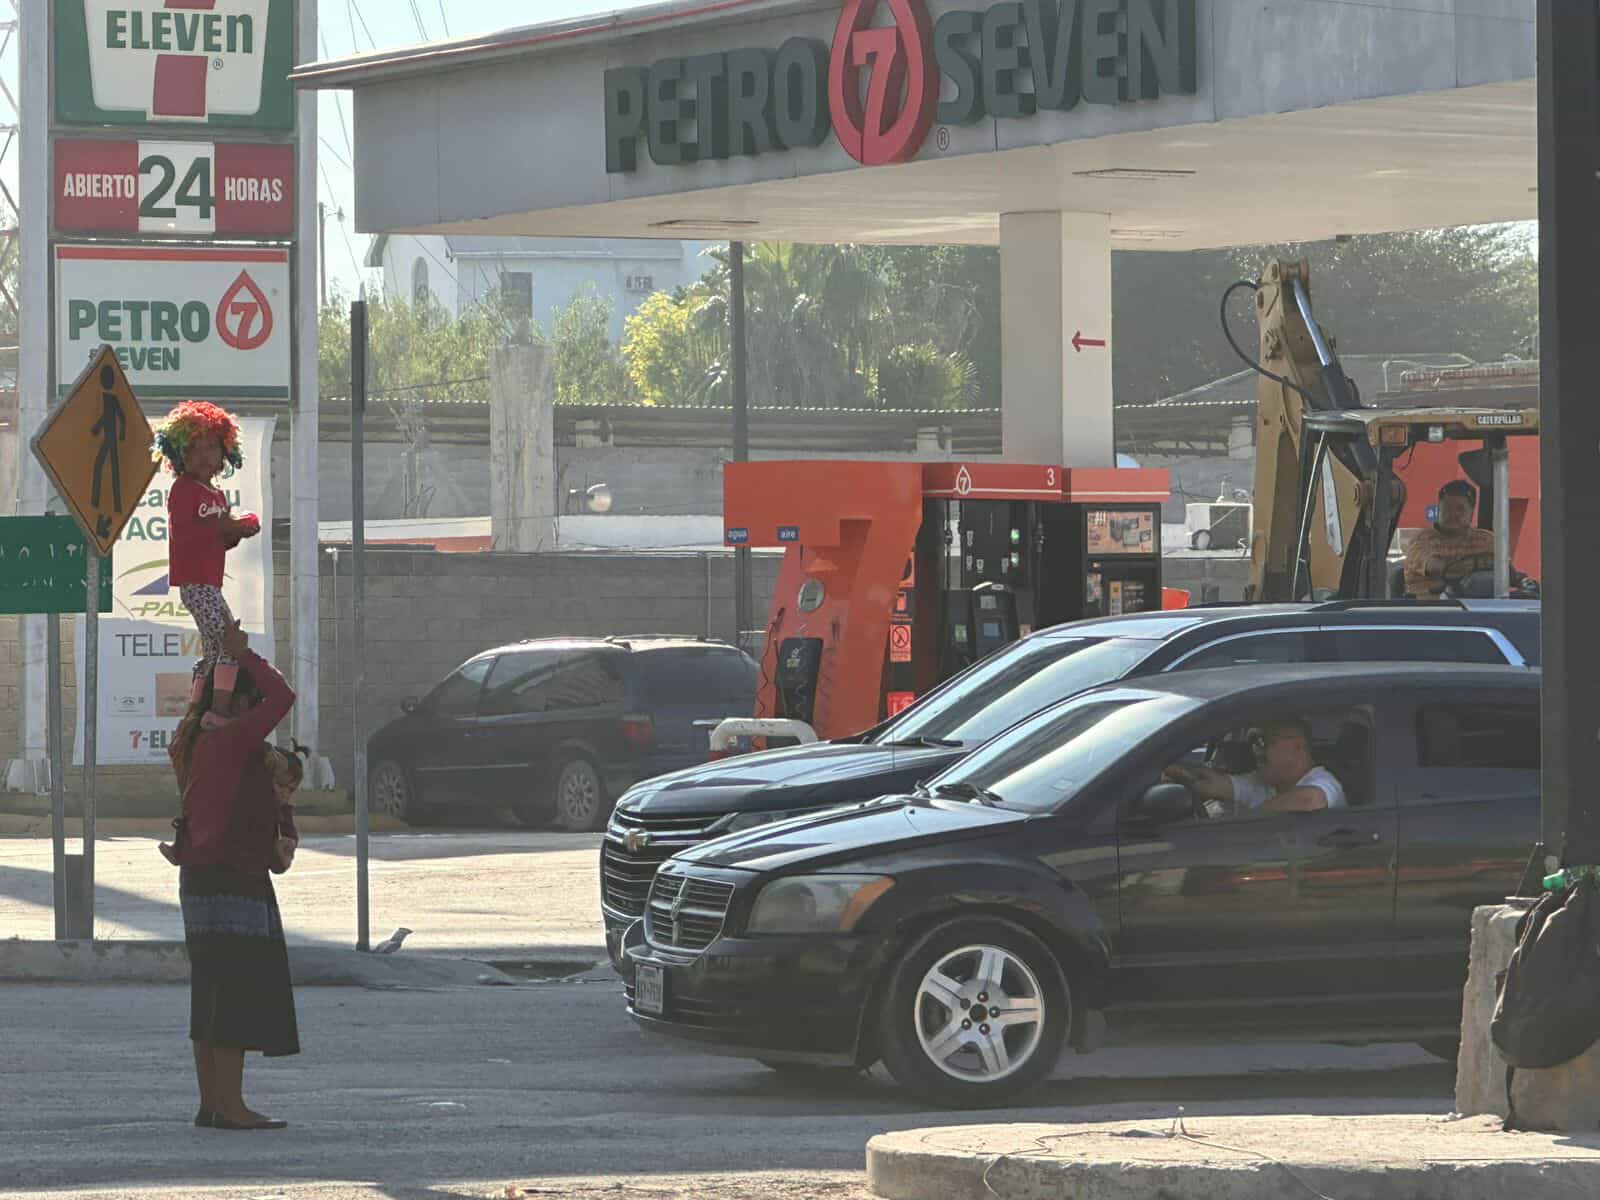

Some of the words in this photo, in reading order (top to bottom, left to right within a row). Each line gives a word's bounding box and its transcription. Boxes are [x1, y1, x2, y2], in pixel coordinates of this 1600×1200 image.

[604, 36, 830, 173] PETRO
[934, 0, 1196, 126] SEVEN
[63, 172, 135, 199] ABIERTO
[139, 155, 216, 219] 24
[224, 177, 283, 202] HORAS
[68, 299, 210, 342] PETRO
[1047, 467, 1055, 486] 3
